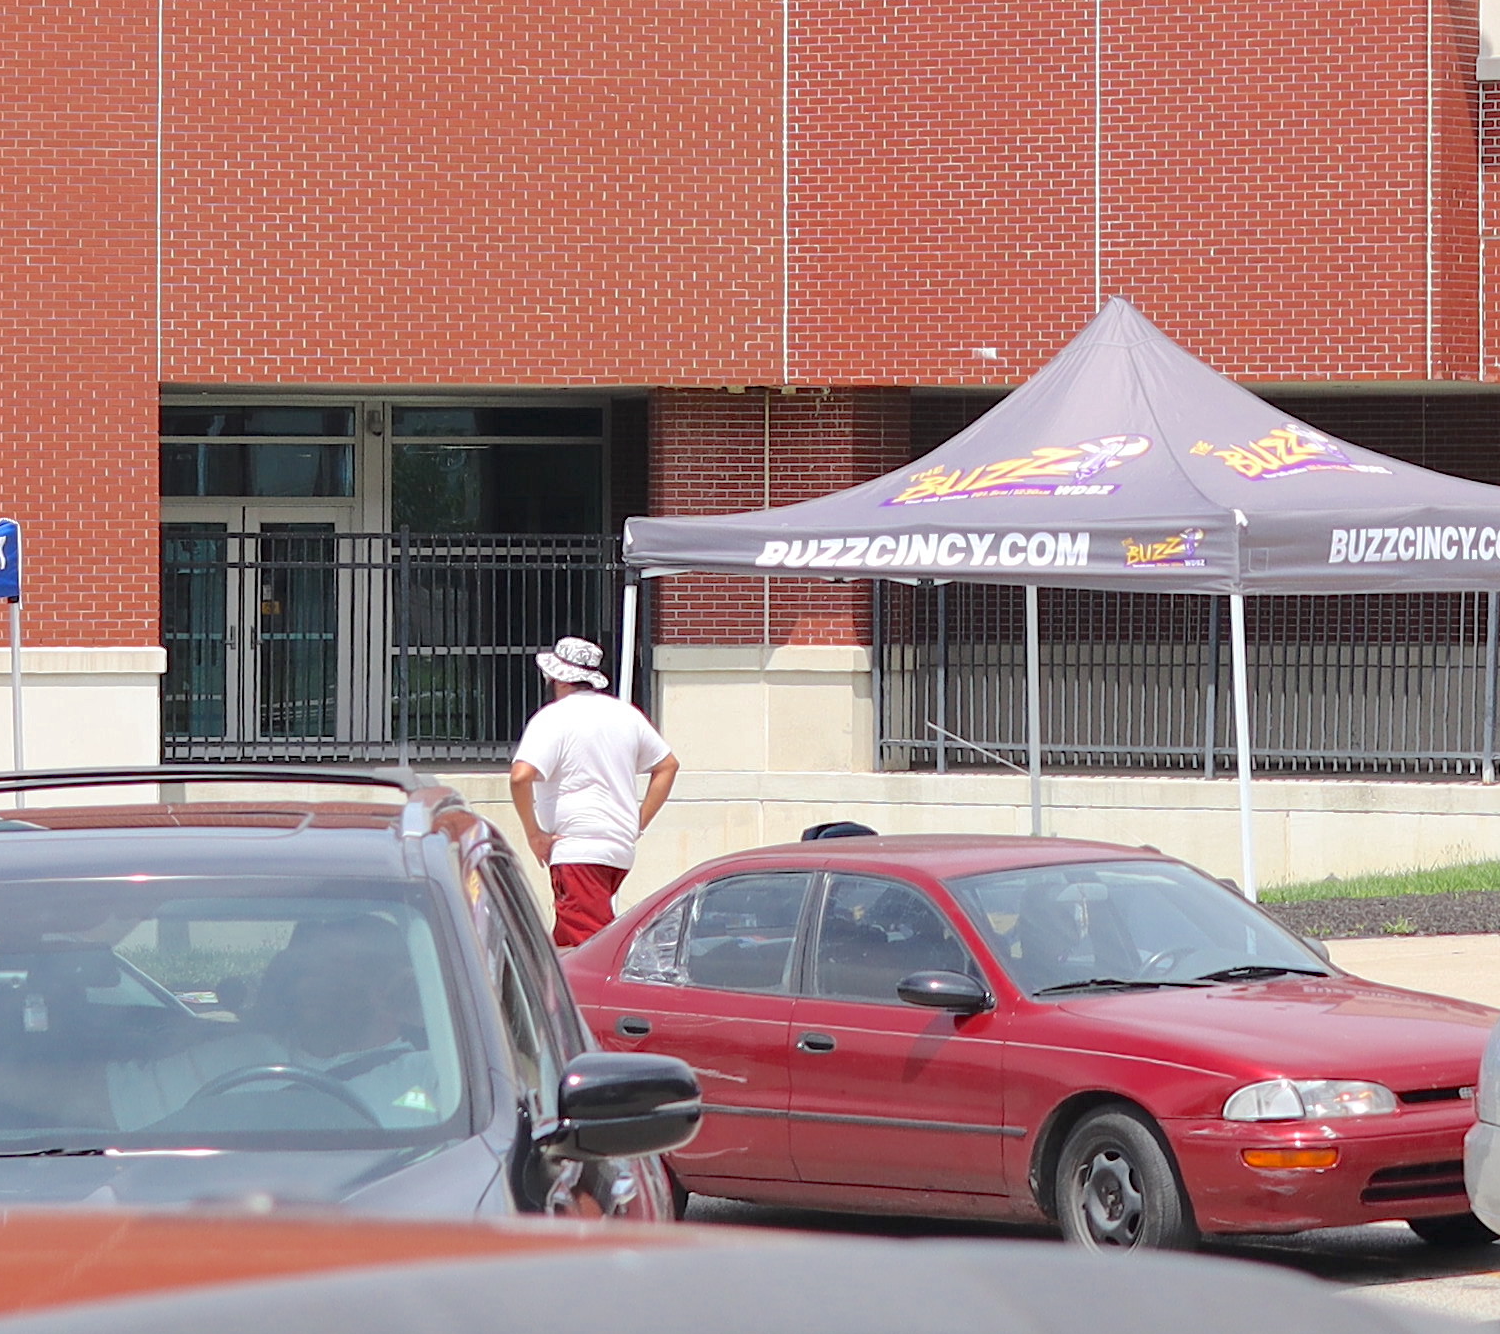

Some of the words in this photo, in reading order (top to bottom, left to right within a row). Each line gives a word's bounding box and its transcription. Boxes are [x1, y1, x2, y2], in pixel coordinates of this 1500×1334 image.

[891, 447, 1083, 503] BUZZ
[1054, 484, 1116, 496] WDBZ
[755, 532, 1090, 568] BUZZCINCY.COM
[1126, 536, 1186, 565] BUZZ
